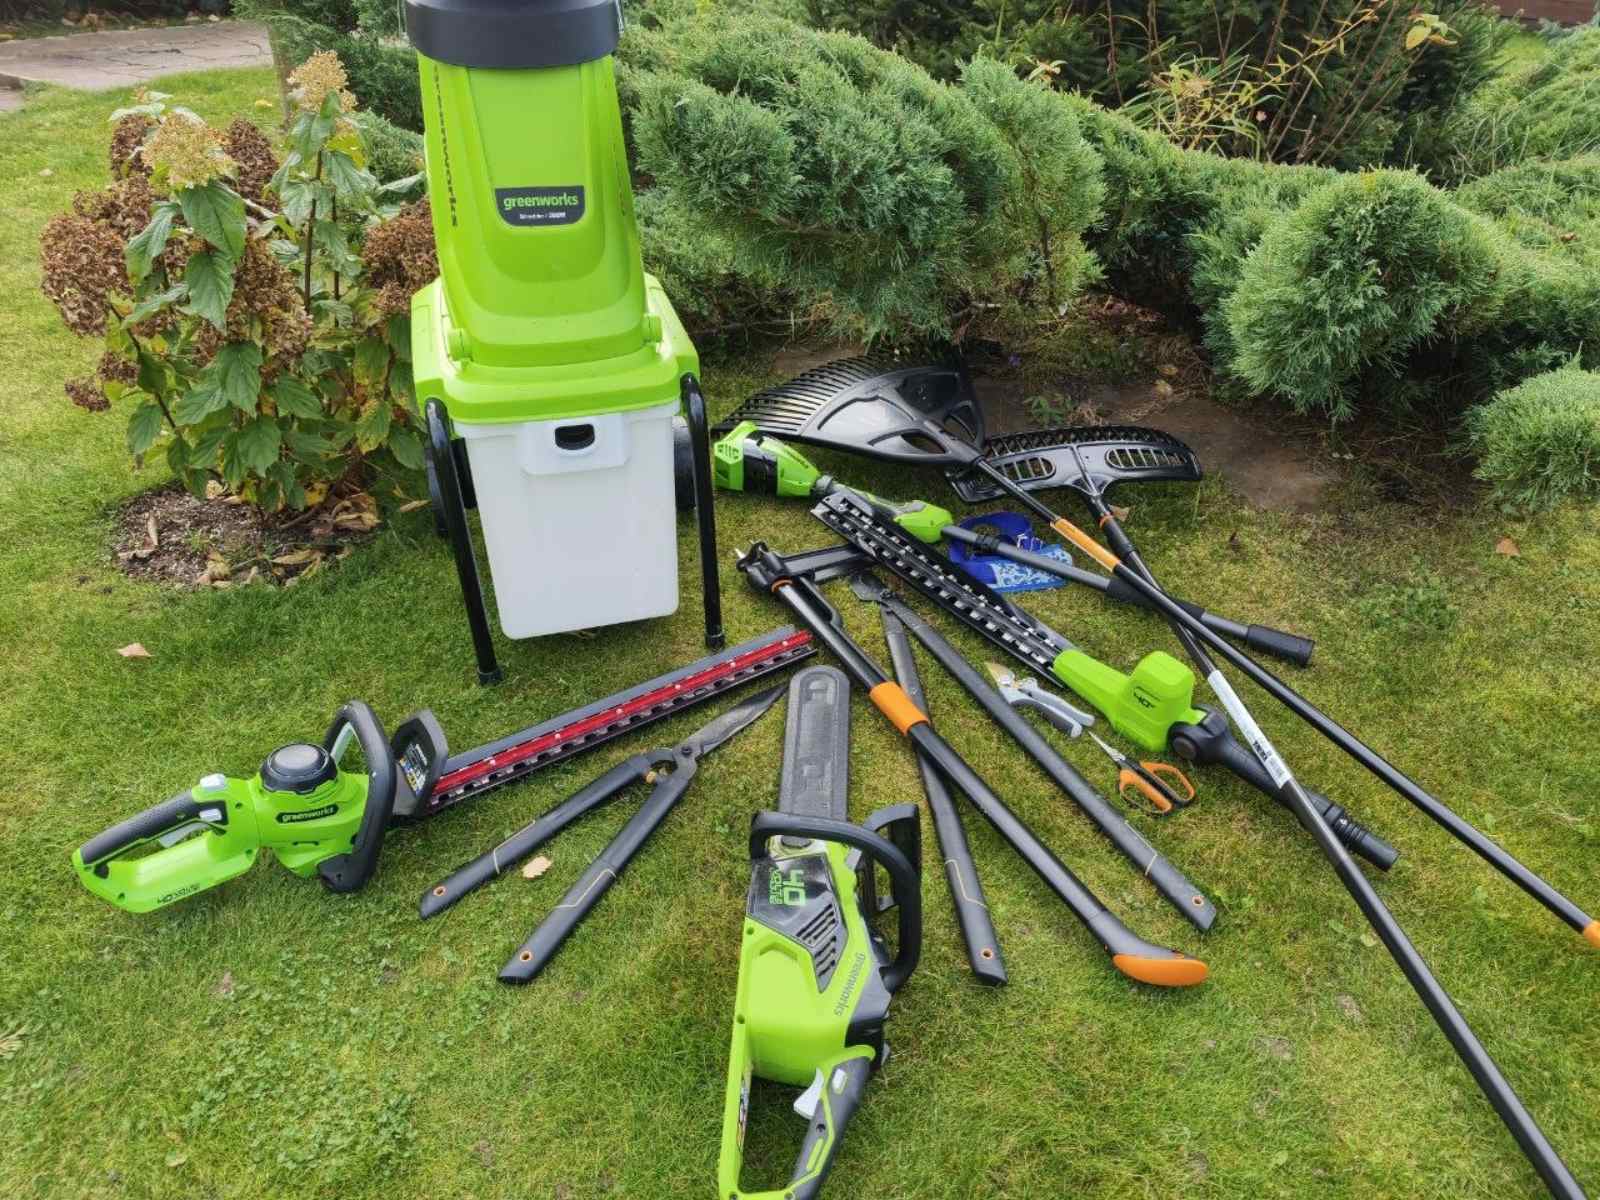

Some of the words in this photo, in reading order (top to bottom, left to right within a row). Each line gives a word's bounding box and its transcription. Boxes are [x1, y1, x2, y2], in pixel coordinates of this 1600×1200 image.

[503, 192, 579, 210] greenworks
[784, 869, 806, 906] 40
[834, 952, 866, 1017] greenworks
